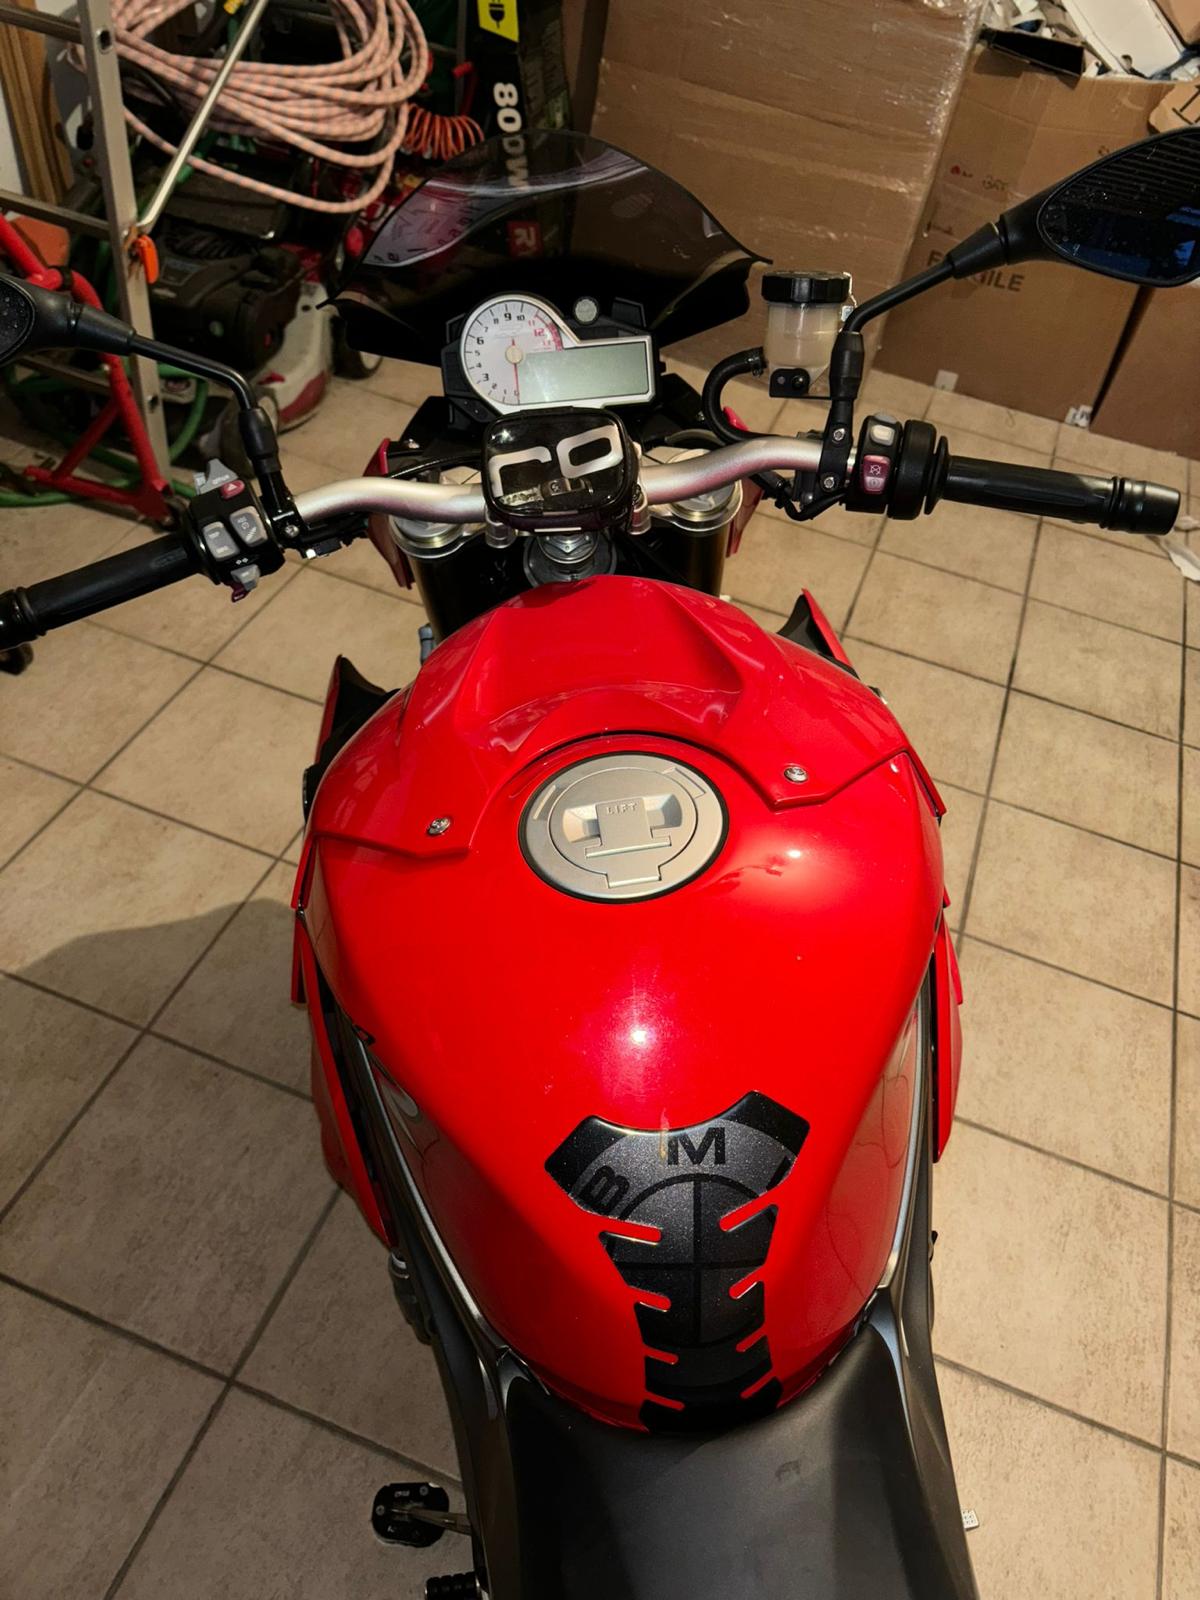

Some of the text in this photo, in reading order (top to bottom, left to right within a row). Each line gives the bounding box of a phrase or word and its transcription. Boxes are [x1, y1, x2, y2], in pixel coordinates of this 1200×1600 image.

[927, 249, 1025, 292] FILE
[503, 312, 512, 321] 9
[476, 336, 485, 345] 6
[481, 373, 490, 382] 3
[606, 801, 639, 816] LIFT
